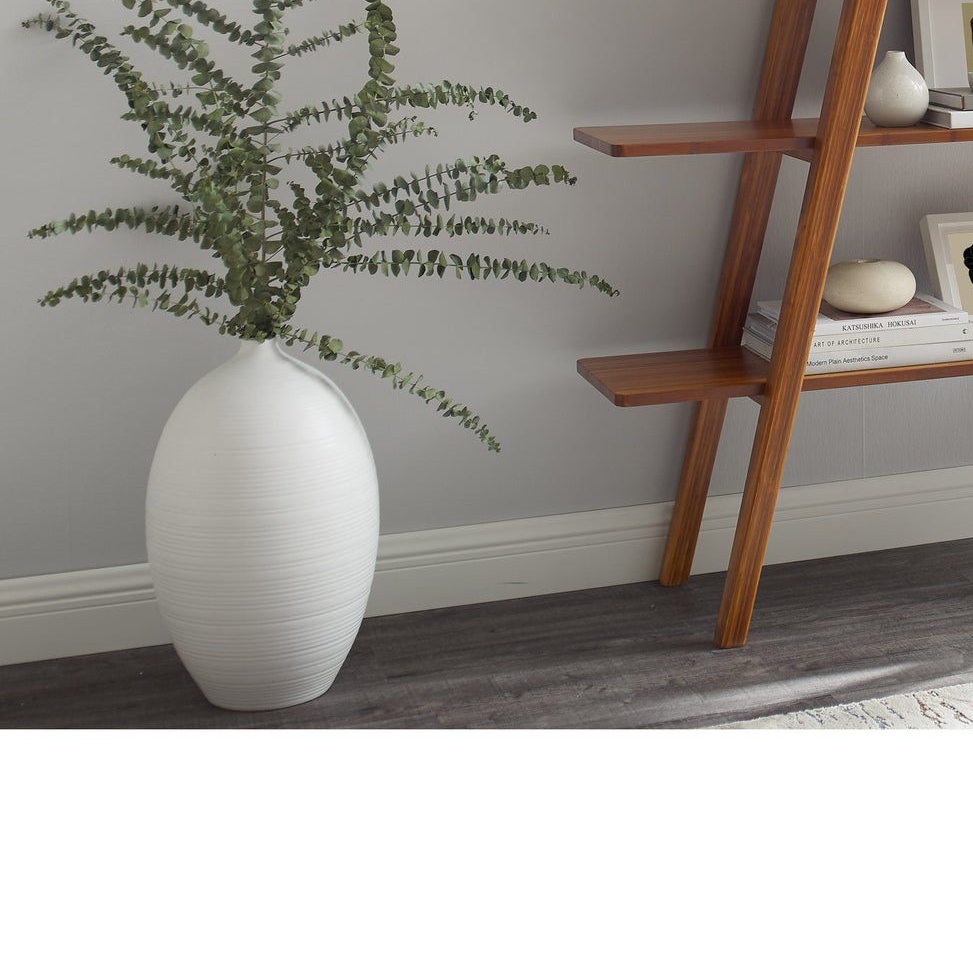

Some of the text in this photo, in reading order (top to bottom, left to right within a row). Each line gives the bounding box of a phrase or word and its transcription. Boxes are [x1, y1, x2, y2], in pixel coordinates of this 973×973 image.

[841, 319, 917, 332] KATSUSHIKA HOKUSAI
[837, 336, 881, 346] ARCHITECTURE
[806, 359, 828, 367] Modern
[842, 356, 870, 364] Aesthetics
[871, 354, 889, 363] Space
